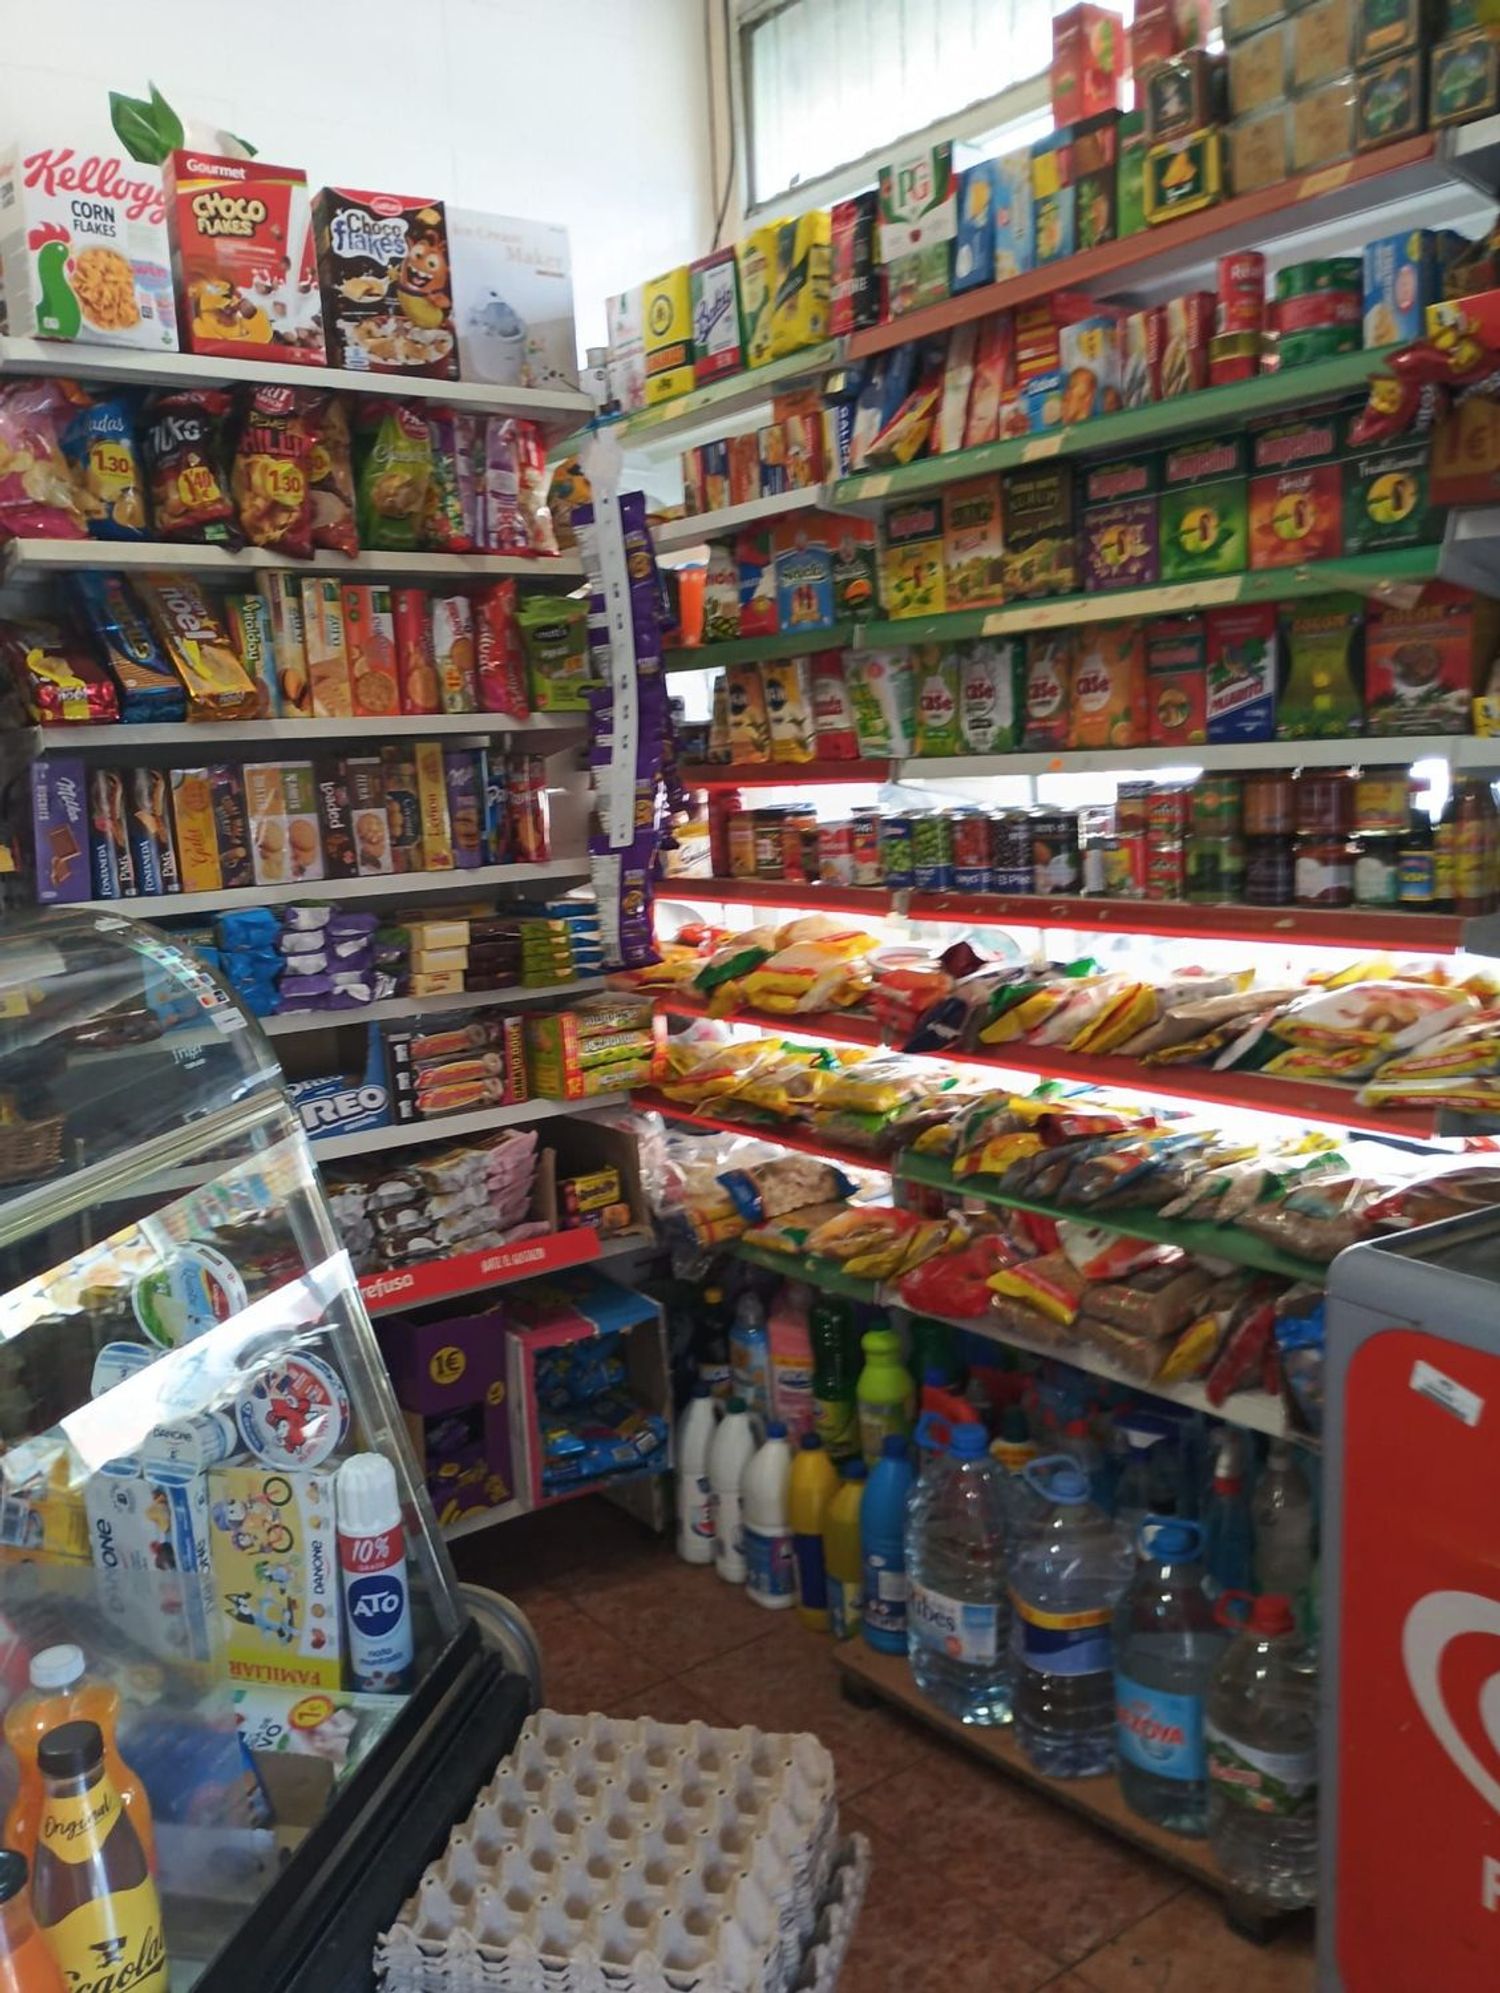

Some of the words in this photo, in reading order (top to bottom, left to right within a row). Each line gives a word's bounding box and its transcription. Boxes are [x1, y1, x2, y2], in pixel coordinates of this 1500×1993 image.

[186, 157, 247, 180] Gourmet
[23, 149, 167, 225] Kellogg
[71, 200, 115, 223] CORN
[192, 192, 267, 222] CHOCO
[73, 219, 117, 238] FLAKES
[197, 216, 254, 237] FLAKES
[347, 213, 401, 237] Choco
[334, 220, 406, 260] flakes
[56, 776, 80, 823] Milka
[97, 843, 112, 897] FONTANEDA
[140, 840, 156, 893] FONTANEDA
[301, 1084, 387, 1130] REO
[361, 1273, 414, 1300] refusa
[433, 1354, 462, 1376] 1€
[350, 1540, 391, 1564] 10%
[309, 1539, 326, 1596] DANONE
[353, 1590, 401, 1619] ATO
[228, 1659, 322, 1688] FAMILIAR
[44, 1792, 112, 1838] Original
